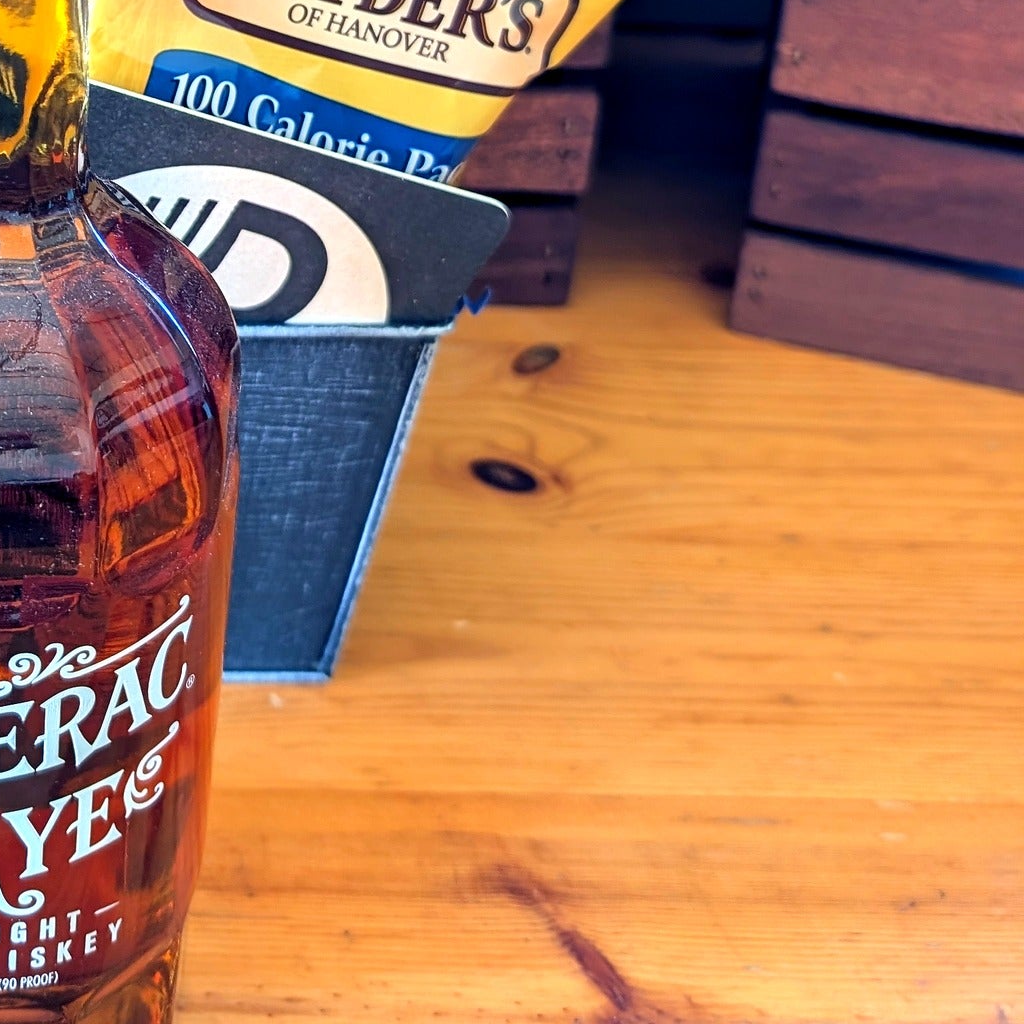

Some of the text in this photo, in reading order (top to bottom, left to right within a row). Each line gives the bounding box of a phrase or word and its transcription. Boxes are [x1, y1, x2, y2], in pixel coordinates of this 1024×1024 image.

[287, 2, 452, 64] OF HANOVER
[172, 71, 463, 184] 100 Calorie Pa
[19, 971, 59, 990] PROOF)
